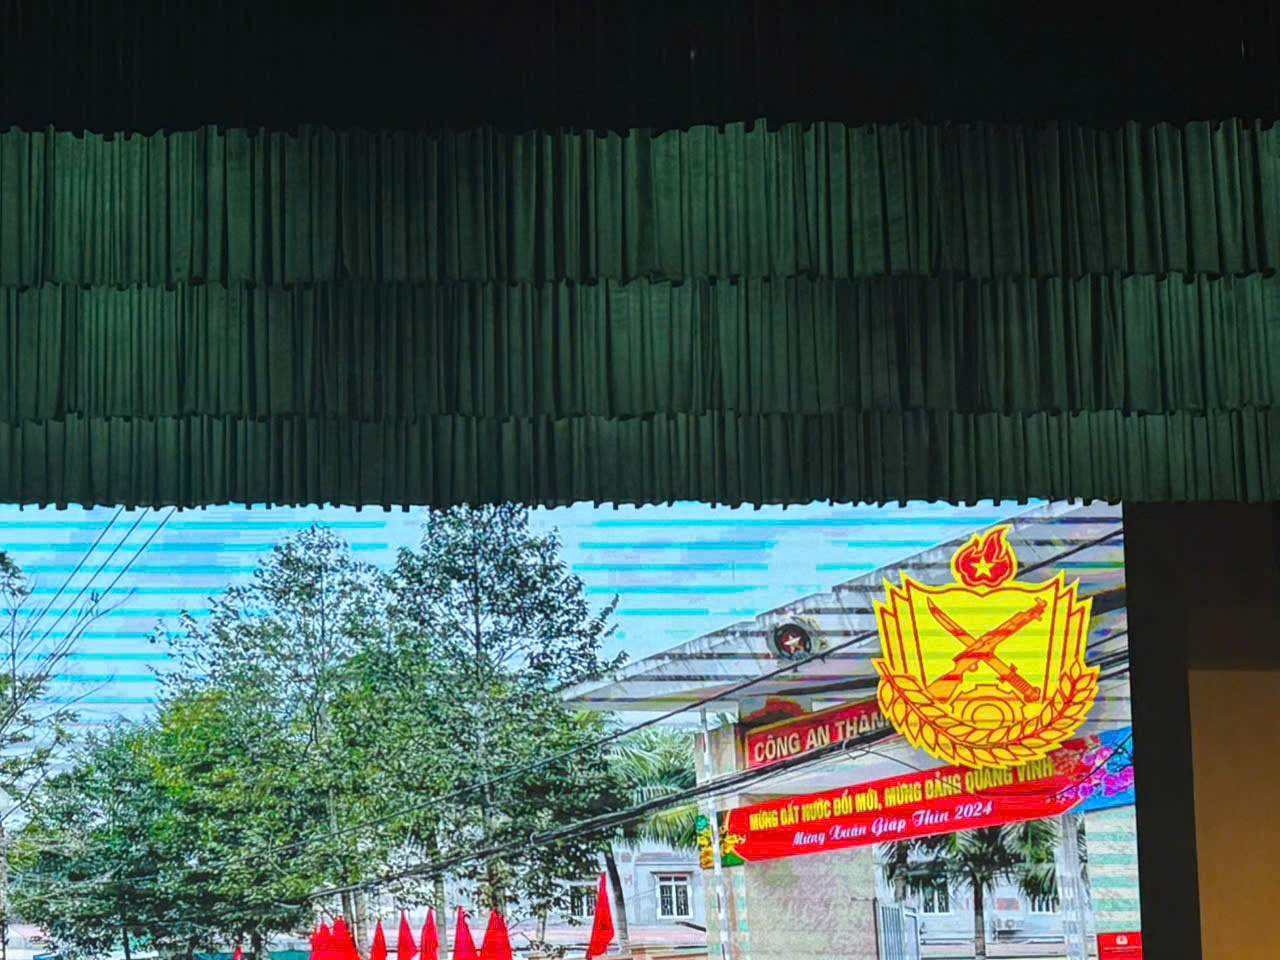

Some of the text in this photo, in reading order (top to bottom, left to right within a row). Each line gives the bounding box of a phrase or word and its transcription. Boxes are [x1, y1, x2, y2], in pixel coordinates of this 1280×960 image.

[754, 733, 801, 762] CÔNG
[805, 724, 831, 751] AN
[924, 771, 963, 799] ĐẢNG
[965, 767, 1014, 795] QUANG
[1017, 758, 1056, 782] VINH
[953, 801, 993, 819] 2024
